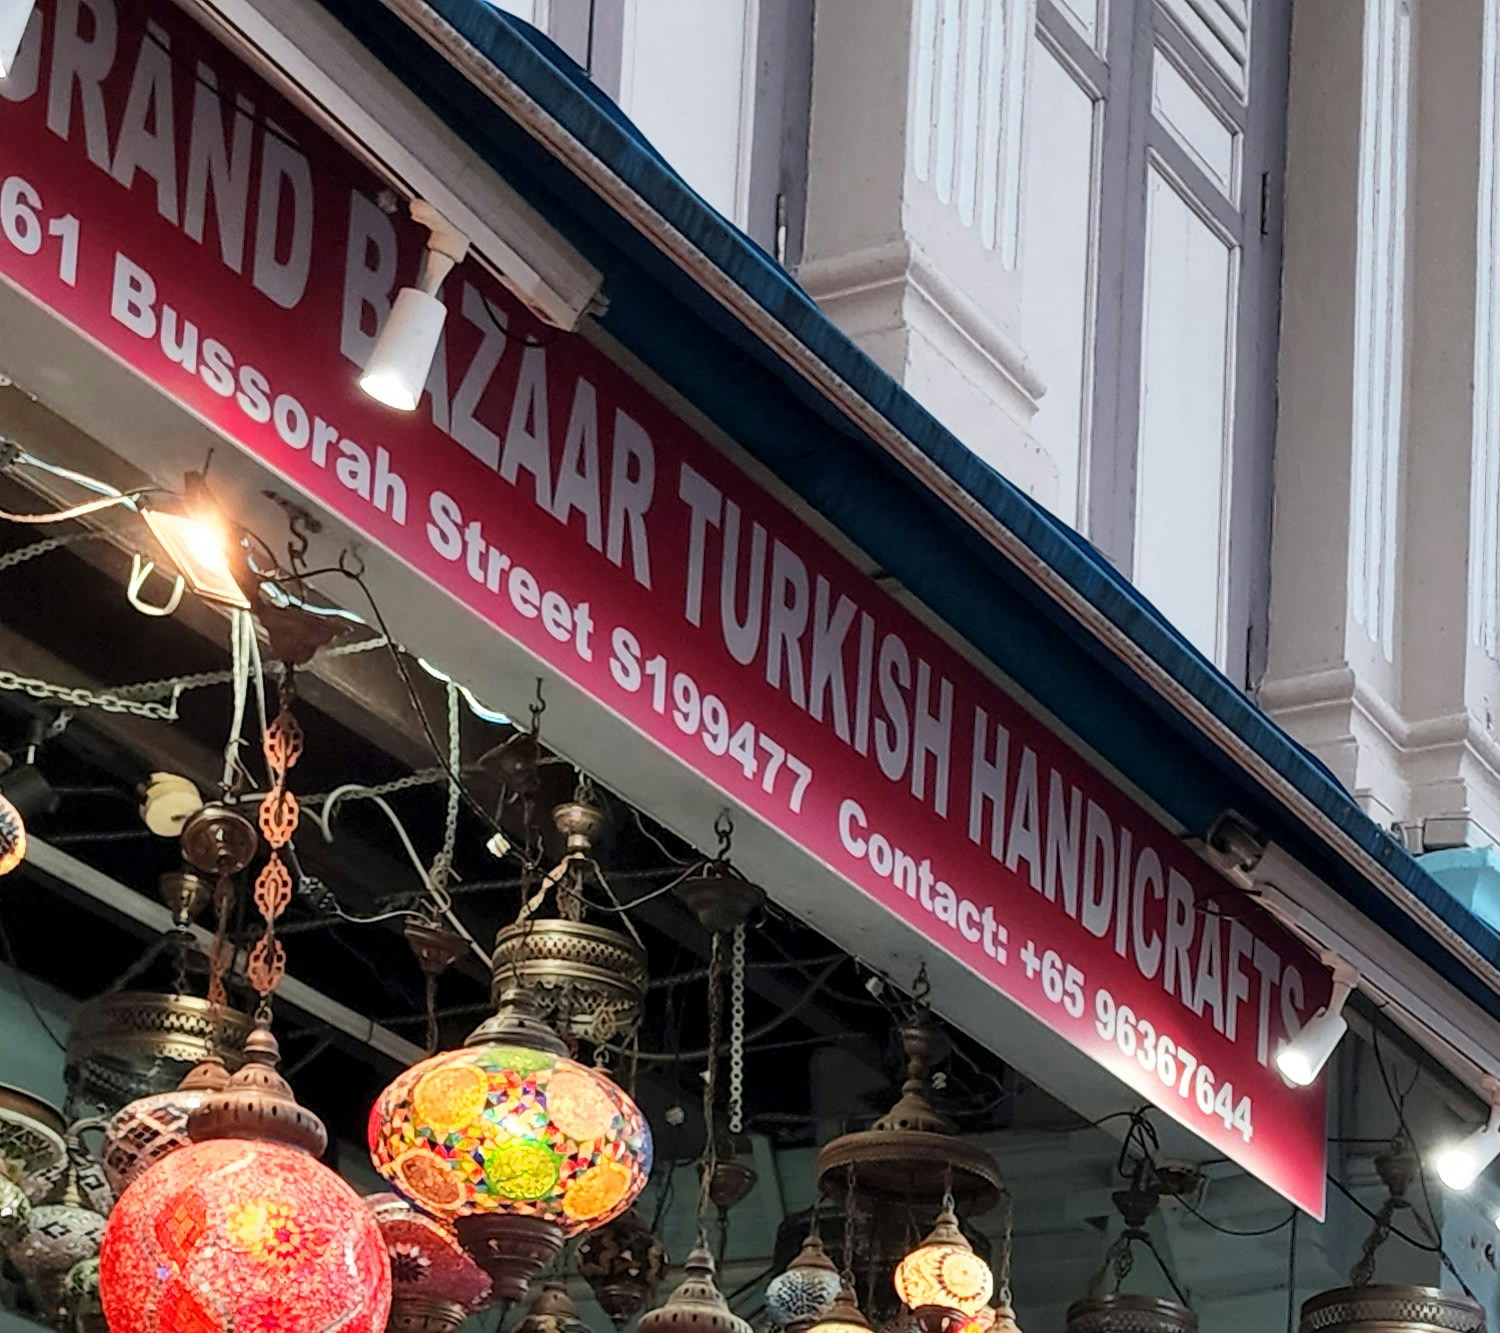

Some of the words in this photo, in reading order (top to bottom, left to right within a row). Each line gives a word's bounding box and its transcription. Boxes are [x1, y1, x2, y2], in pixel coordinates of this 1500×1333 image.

[1, 175, 82, 289] 61
[110, 251, 408, 525] Bussorah
[427, 489, 595, 662] Street
[608, 627, 814, 815] S199477
[838, 797, 1008, 967] Contact:
[1020, 938, 1085, 1018] +65
[1094, 989, 1254, 1145] 96367644
[678, 461, 955, 819] TURKISH
